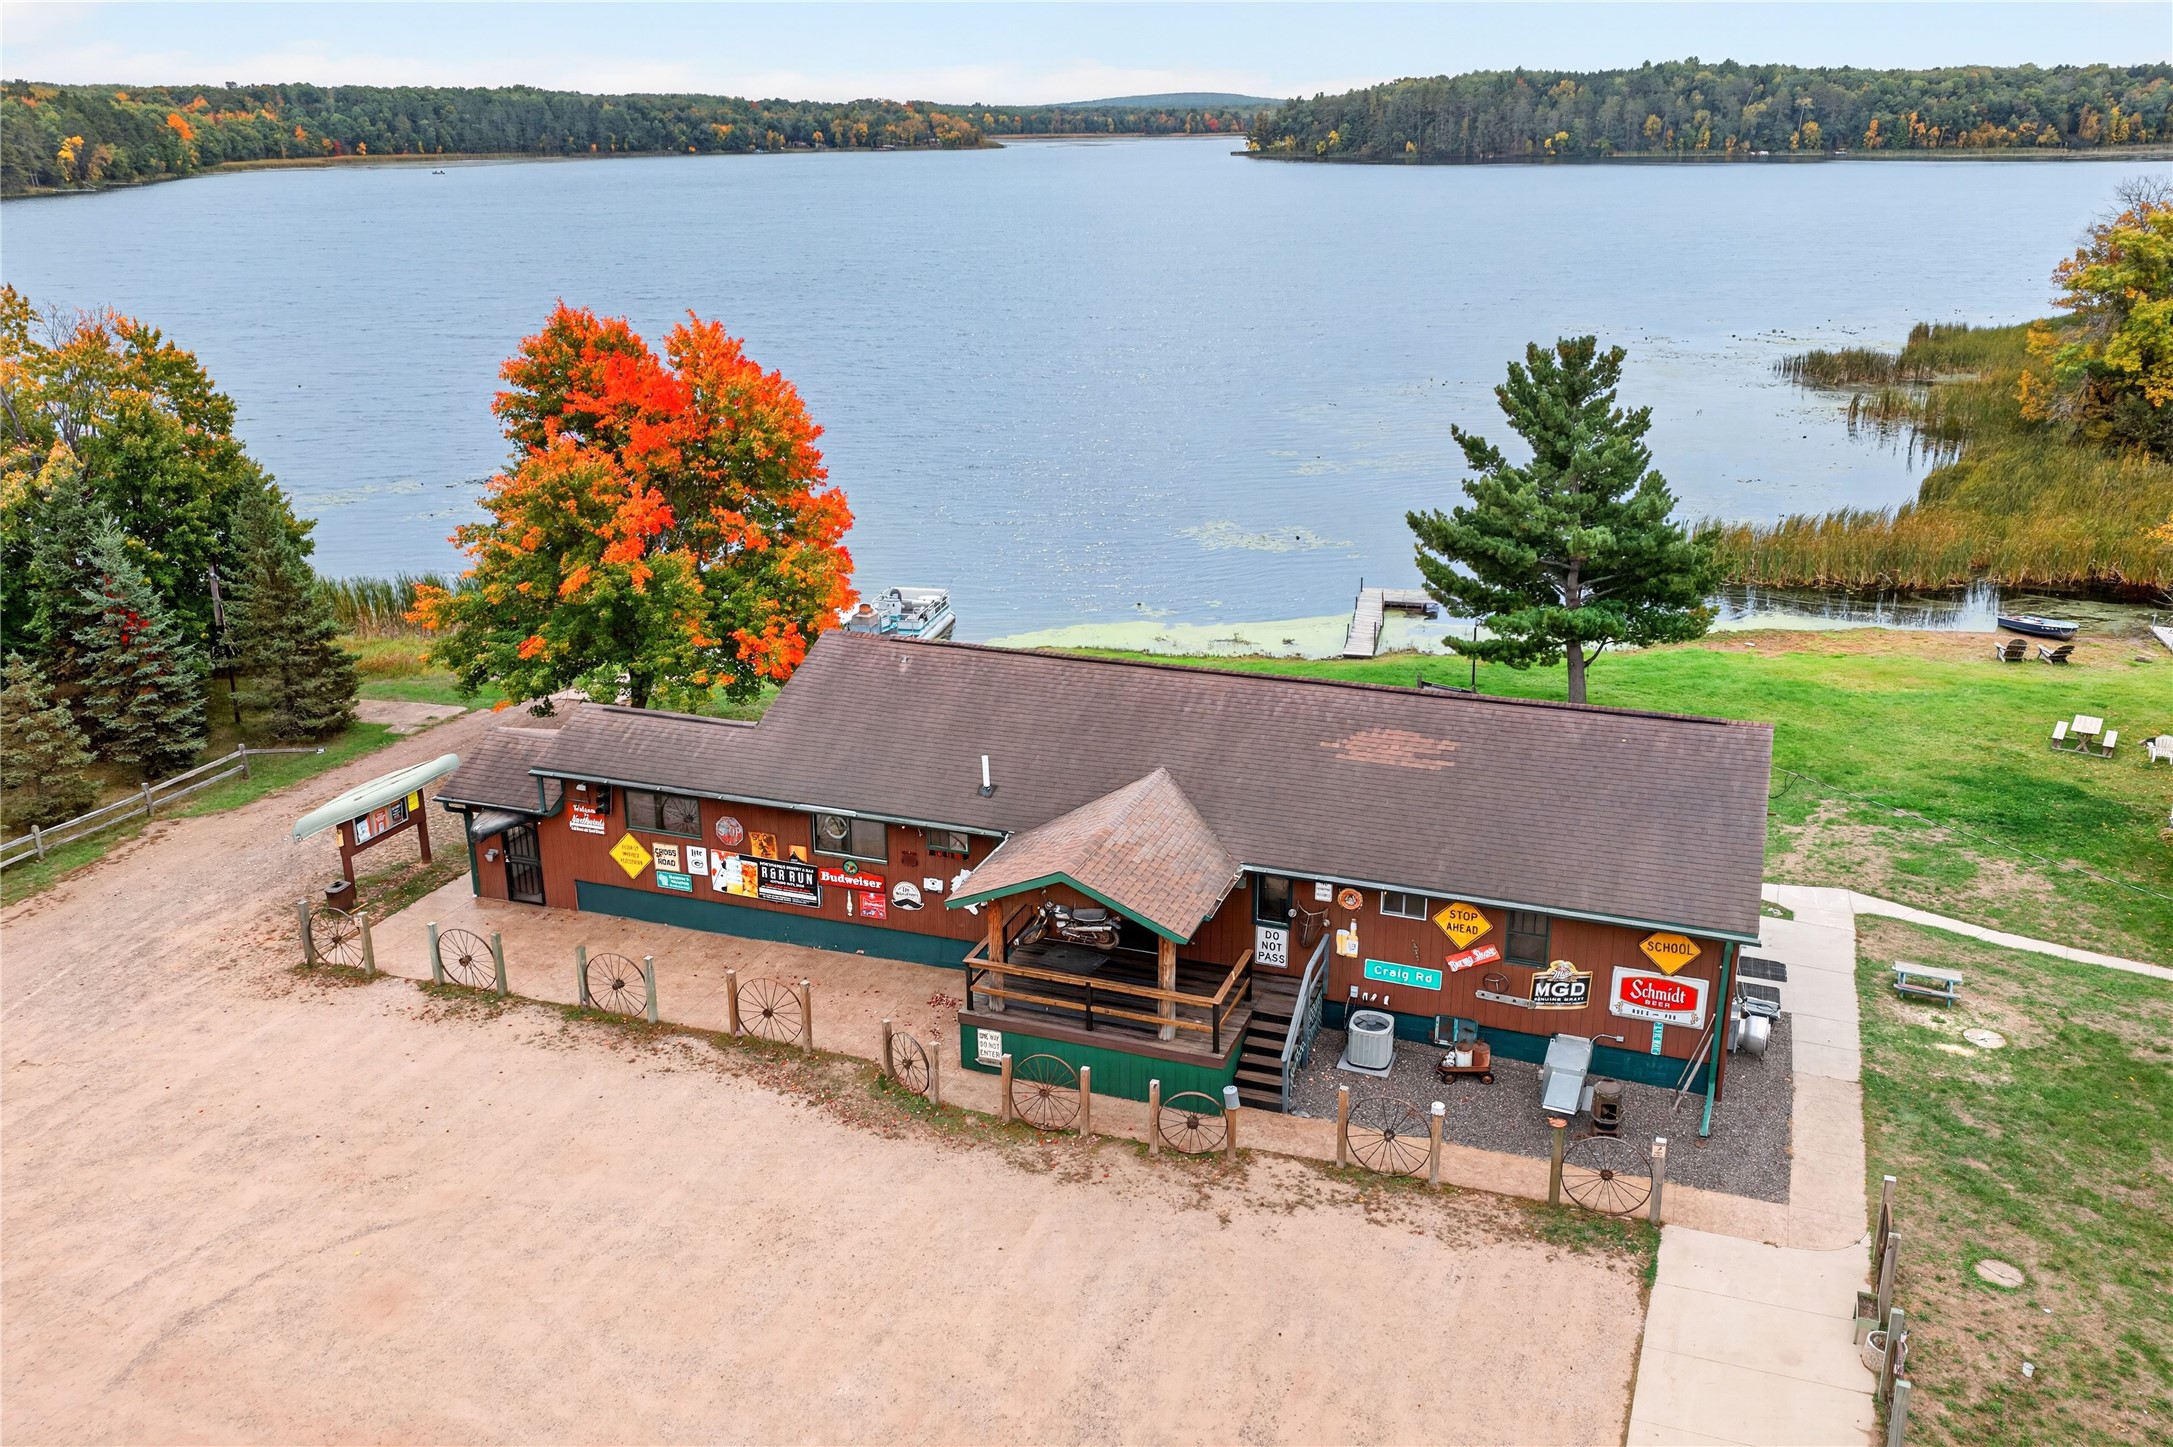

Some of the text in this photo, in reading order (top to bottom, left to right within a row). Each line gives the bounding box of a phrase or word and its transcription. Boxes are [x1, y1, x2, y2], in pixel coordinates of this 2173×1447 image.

[654, 847, 677, 857] CROSS
[691, 849, 703, 857] Lite
[657, 859, 676, 867] ROAD
[789, 871, 813, 885] RUN
[820, 871, 883, 888] Budweiser
[1449, 910, 1478, 921] STOP
[1446, 922, 1479, 934] AHEAD
[1265, 931, 1280, 940] DO
[1261, 941, 1282, 952] NOT
[1647, 941, 1694, 955] SCHOOL
[1258, 951, 1285, 964] PASS
[1374, 965, 1433, 983] Craig Rd
[1535, 982, 1586, 997] MGD
[1630, 979, 1687, 1004] Schmidt
[1644, 1000, 1671, 1008] BEER
[980, 1049, 1000, 1057] ENTER
